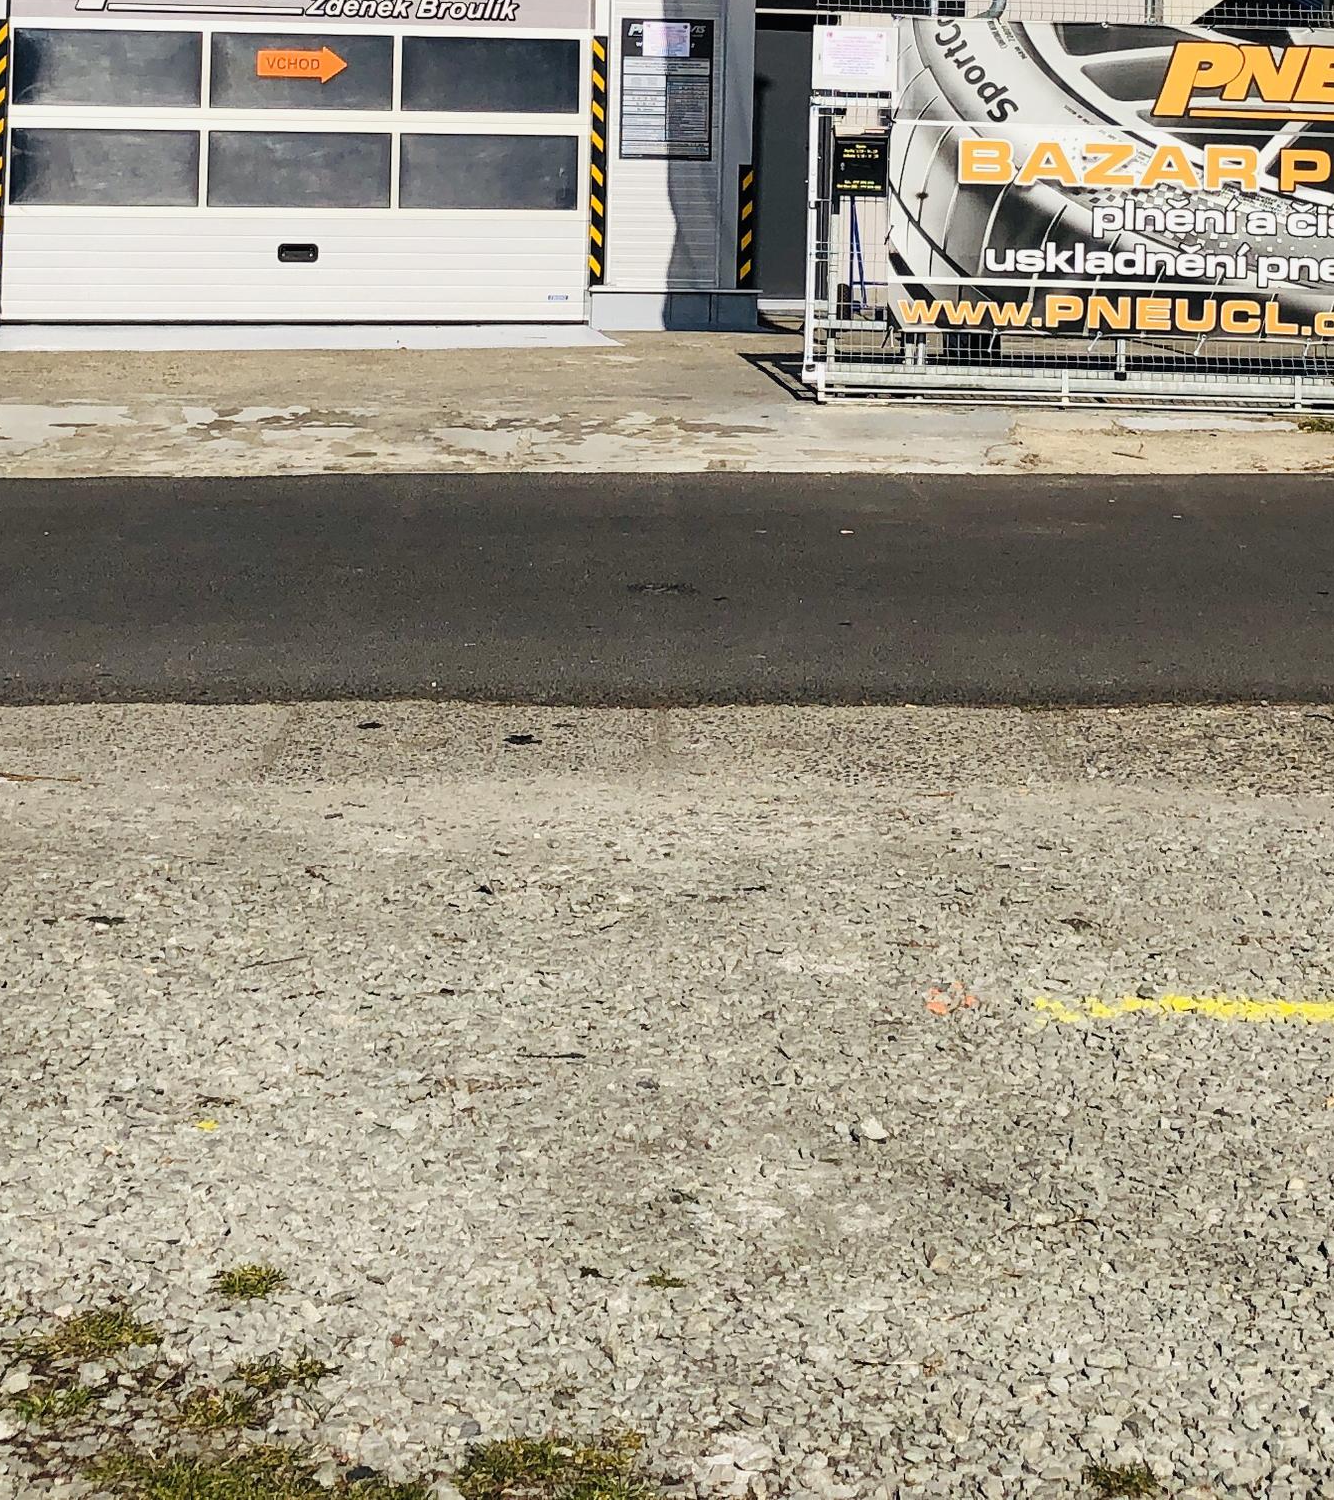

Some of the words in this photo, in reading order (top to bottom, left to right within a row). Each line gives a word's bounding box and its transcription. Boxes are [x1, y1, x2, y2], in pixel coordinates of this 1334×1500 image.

[266, 54, 321, 72] VCHOD
[958, 138, 1259, 192] BAZAR
[1092, 197, 1238, 240] plnění
[1245, 209, 1276, 236] a
[985, 241, 1248, 282] uskladnění
